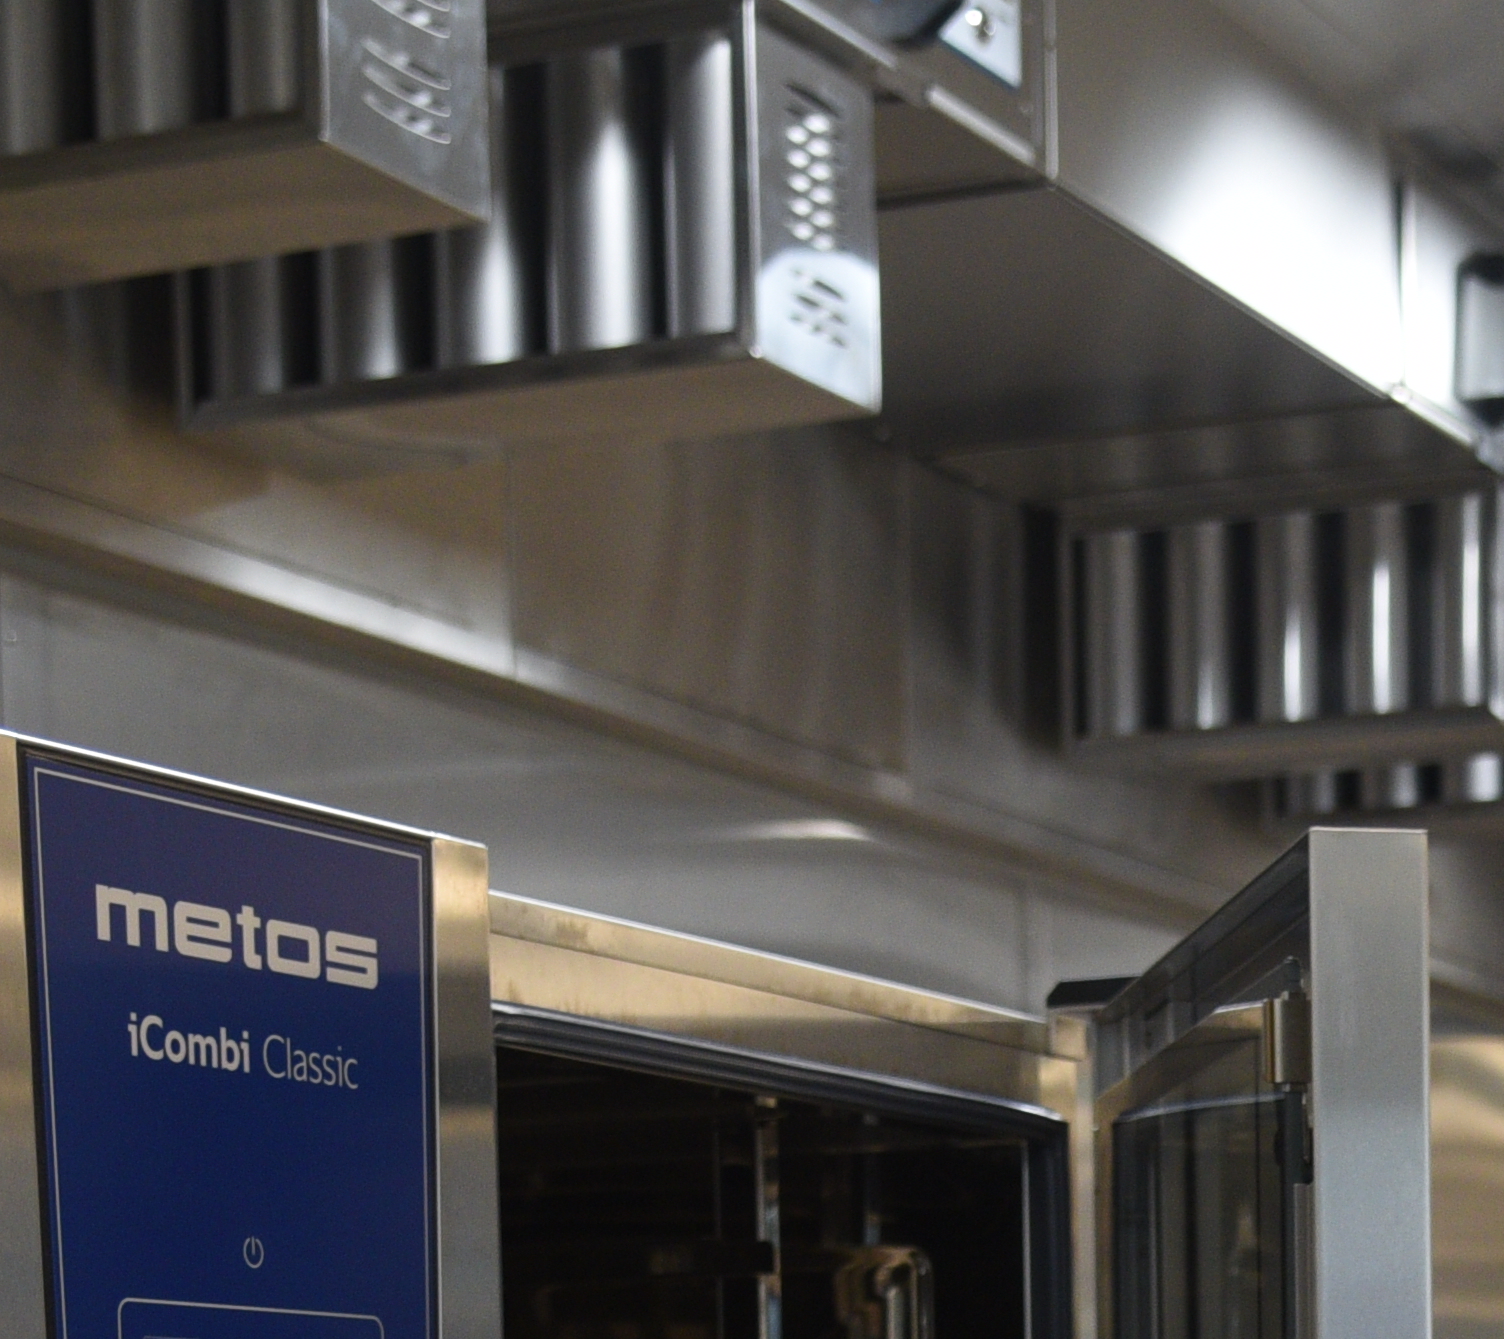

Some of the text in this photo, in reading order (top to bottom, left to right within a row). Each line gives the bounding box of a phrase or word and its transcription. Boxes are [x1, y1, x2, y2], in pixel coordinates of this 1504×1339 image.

[95, 883, 379, 990] metos
[127, 1011, 359, 1090] iCombi Classic
